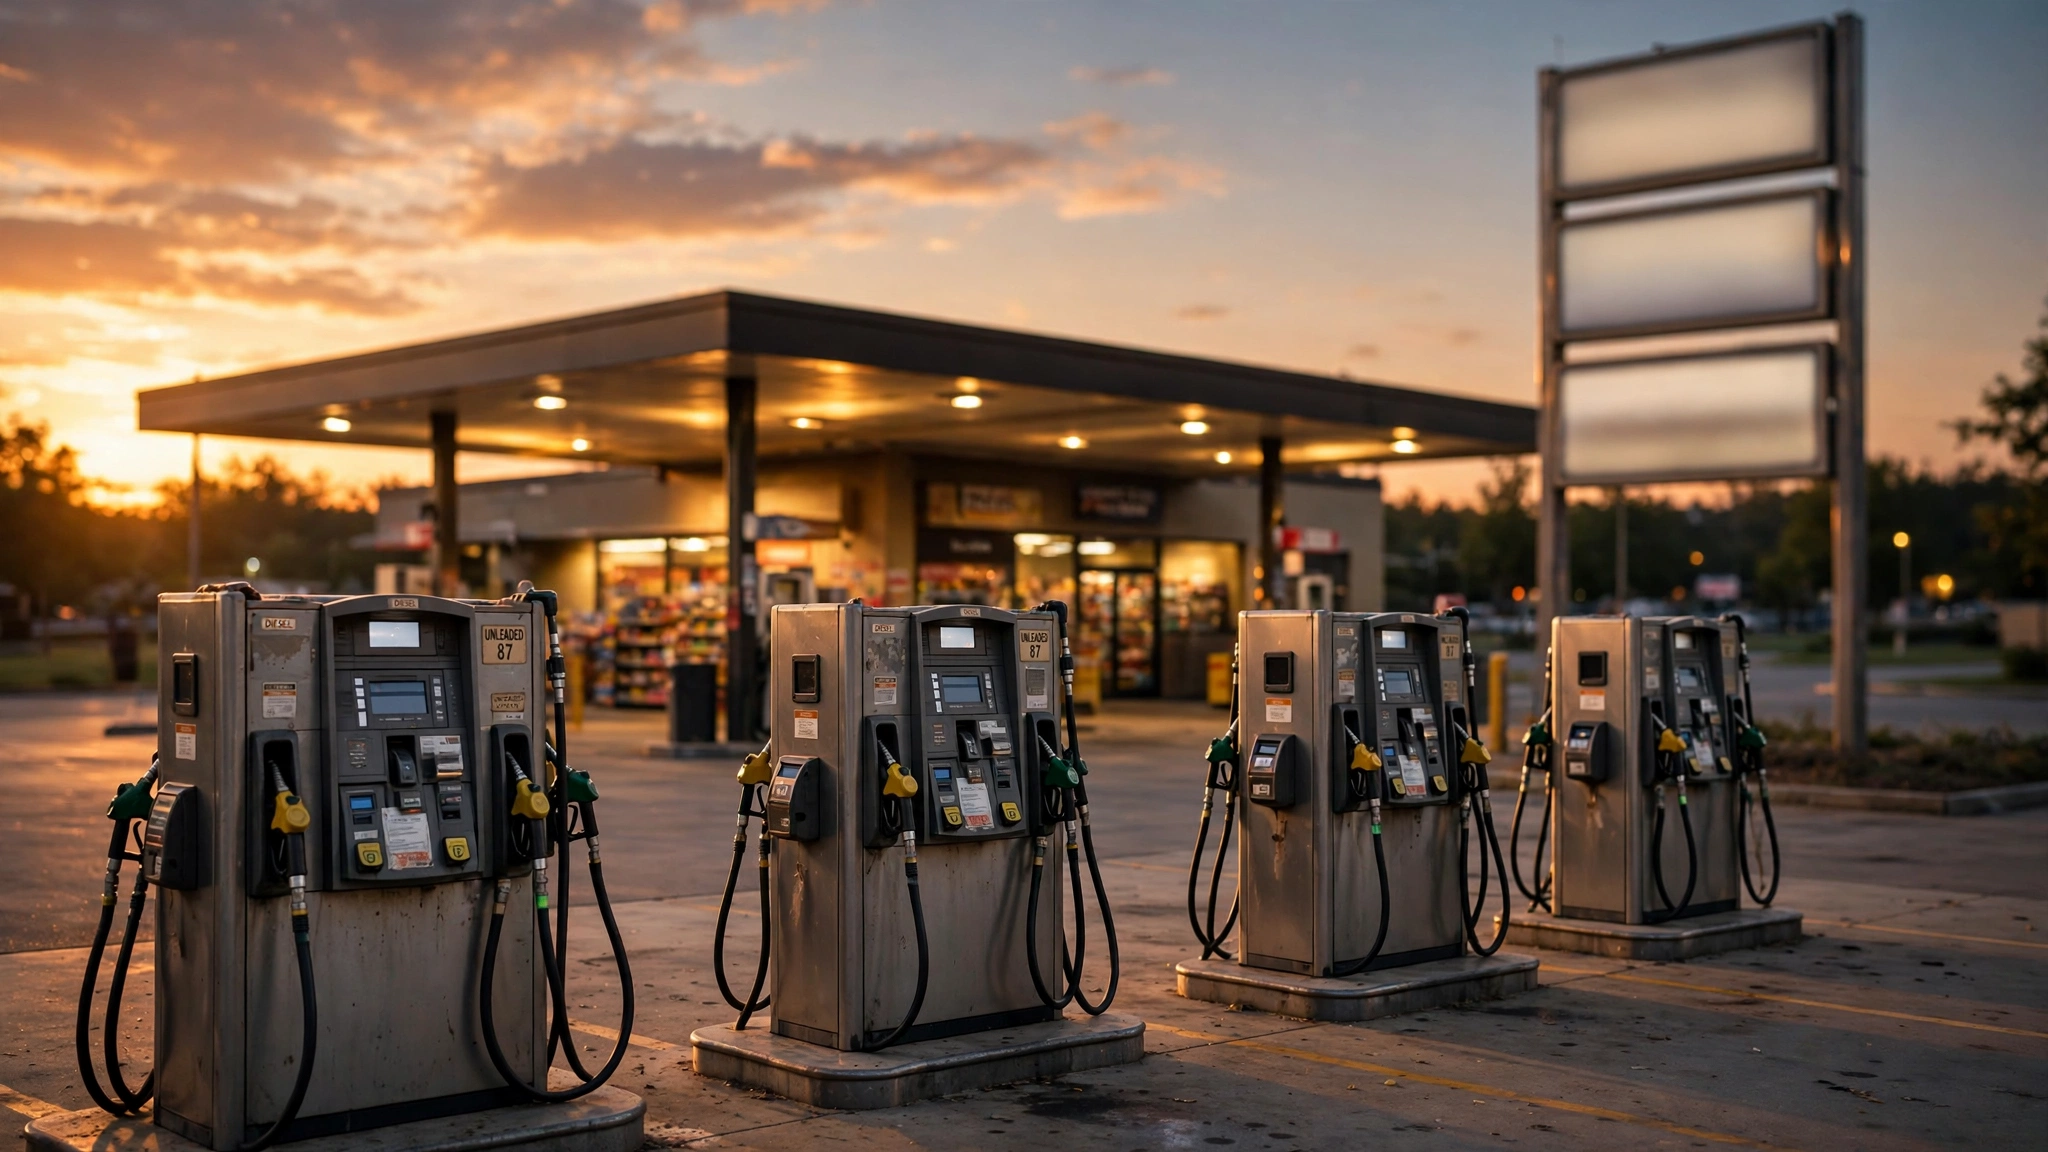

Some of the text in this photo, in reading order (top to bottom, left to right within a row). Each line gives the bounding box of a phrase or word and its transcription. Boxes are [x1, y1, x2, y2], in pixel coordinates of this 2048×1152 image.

[484, 628, 524, 641] UNLEADED
[1020, 632, 1049, 643] UNLEADED
[497, 643, 513, 660] 87
[1029, 645, 1041, 659] 87
